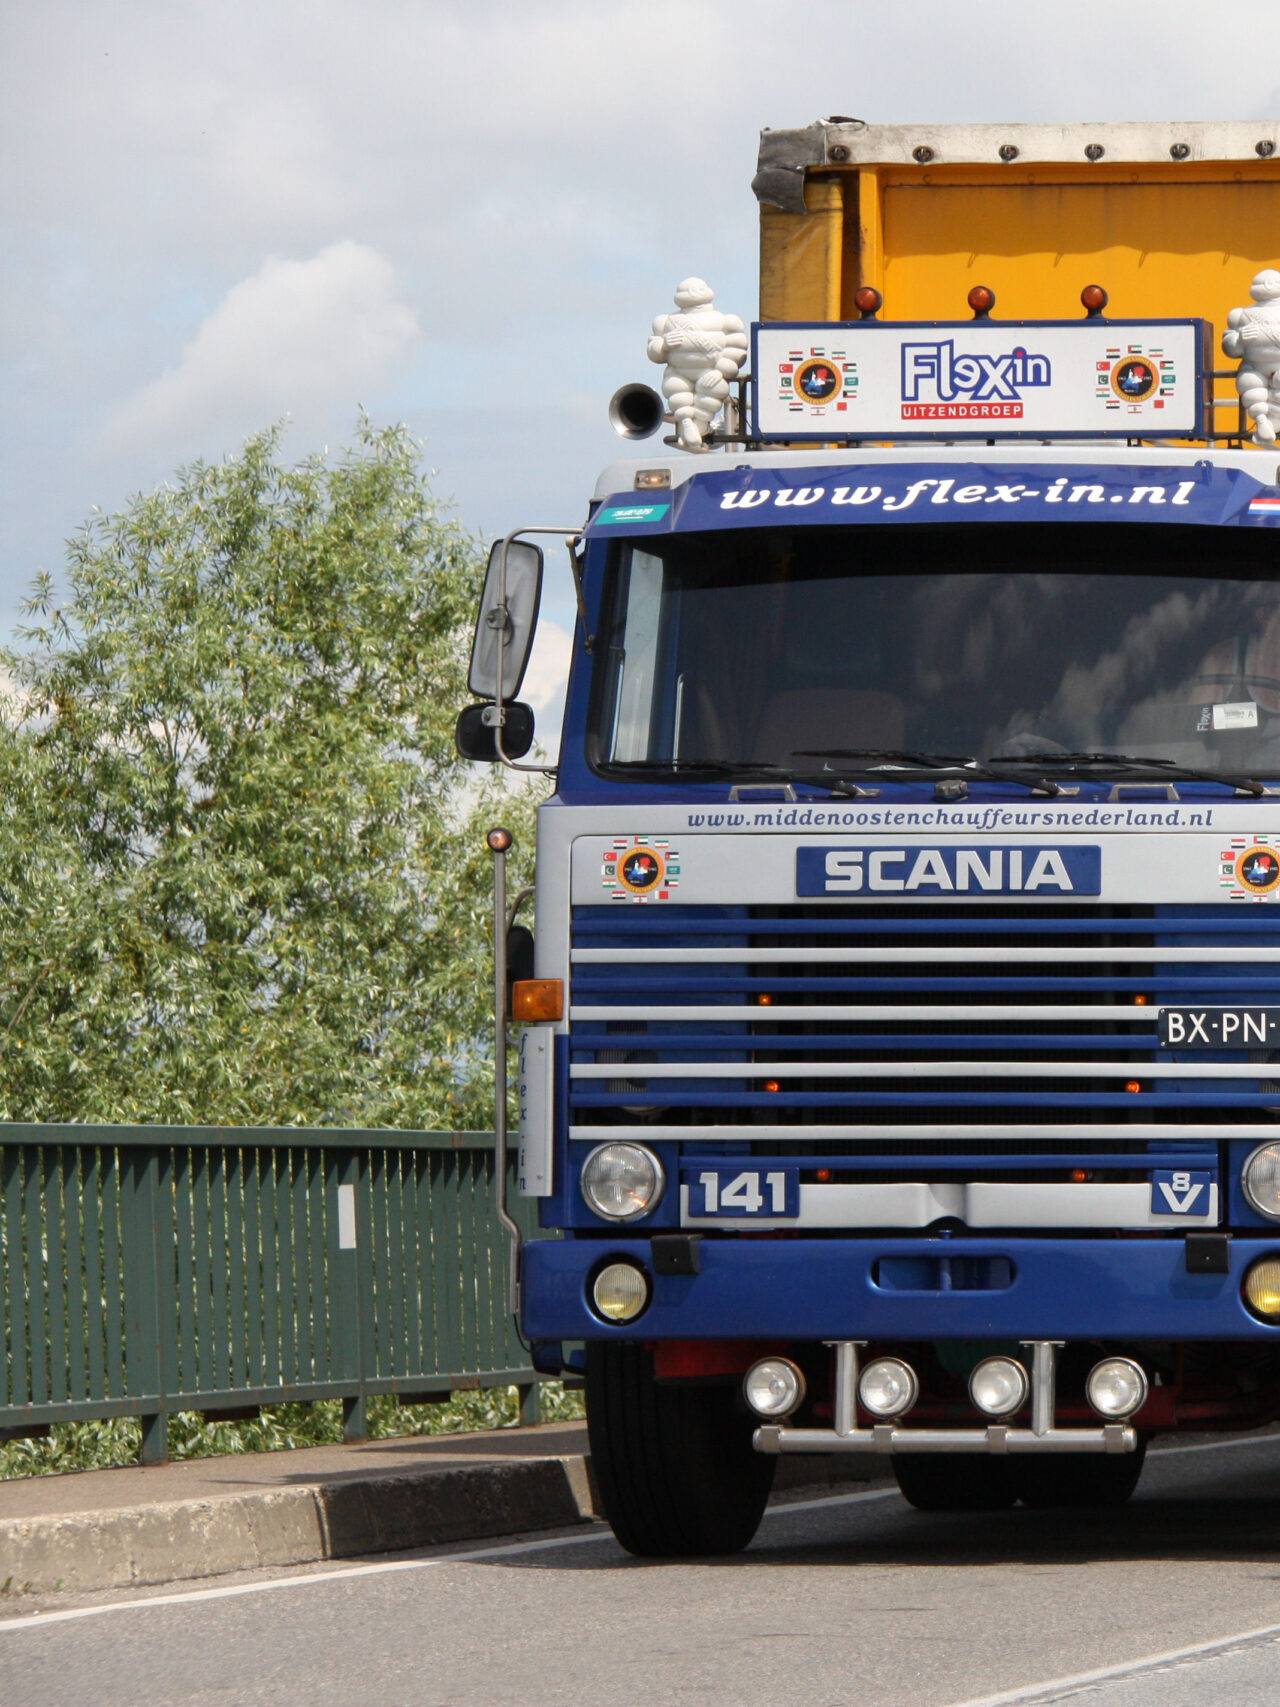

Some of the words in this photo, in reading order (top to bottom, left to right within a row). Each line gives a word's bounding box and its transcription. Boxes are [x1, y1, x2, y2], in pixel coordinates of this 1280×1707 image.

[901, 339, 1051, 401] Flexin
[902, 405, 1023, 418] UITZENDGROEP
[720, 478, 1196, 511] www.flex-in.nl
[688, 808, 1213, 829] www.middenoostenchauffeursnederland.nl
[825, 849, 1074, 891] SCANIA
[519, 1033, 528, 1190] flex-in
[700, 1172, 785, 1212] 141
